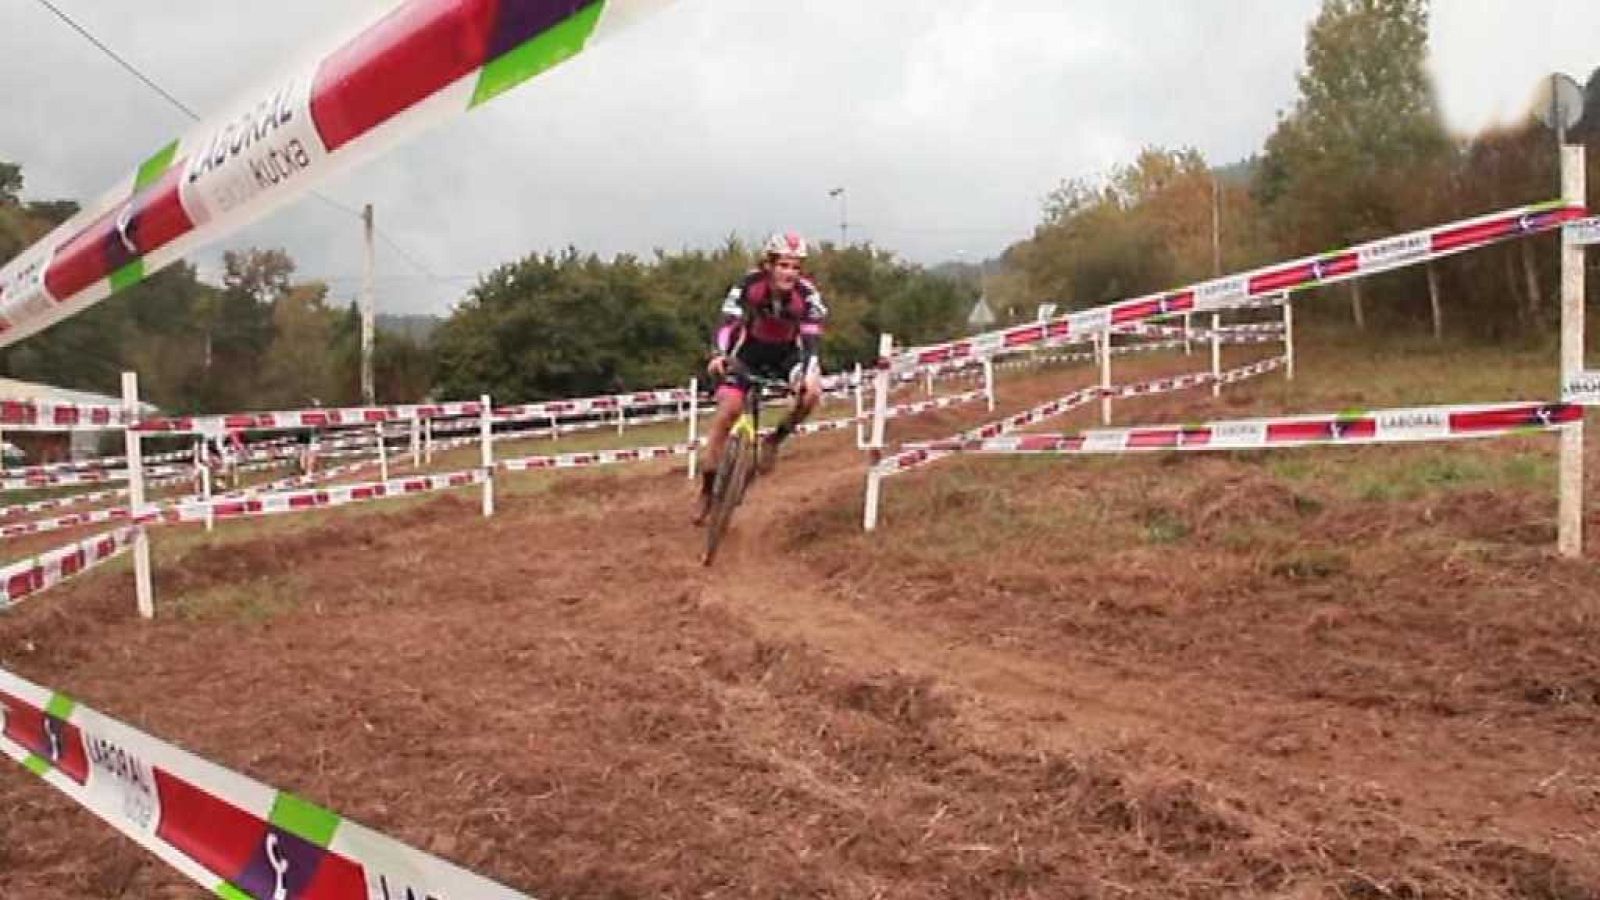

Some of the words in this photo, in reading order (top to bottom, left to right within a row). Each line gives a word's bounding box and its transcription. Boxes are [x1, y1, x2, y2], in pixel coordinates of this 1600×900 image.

[249, 138, 309, 189] kutxa
[1382, 412, 1441, 427] LABORAL
[86, 734, 150, 795] LABORAL
